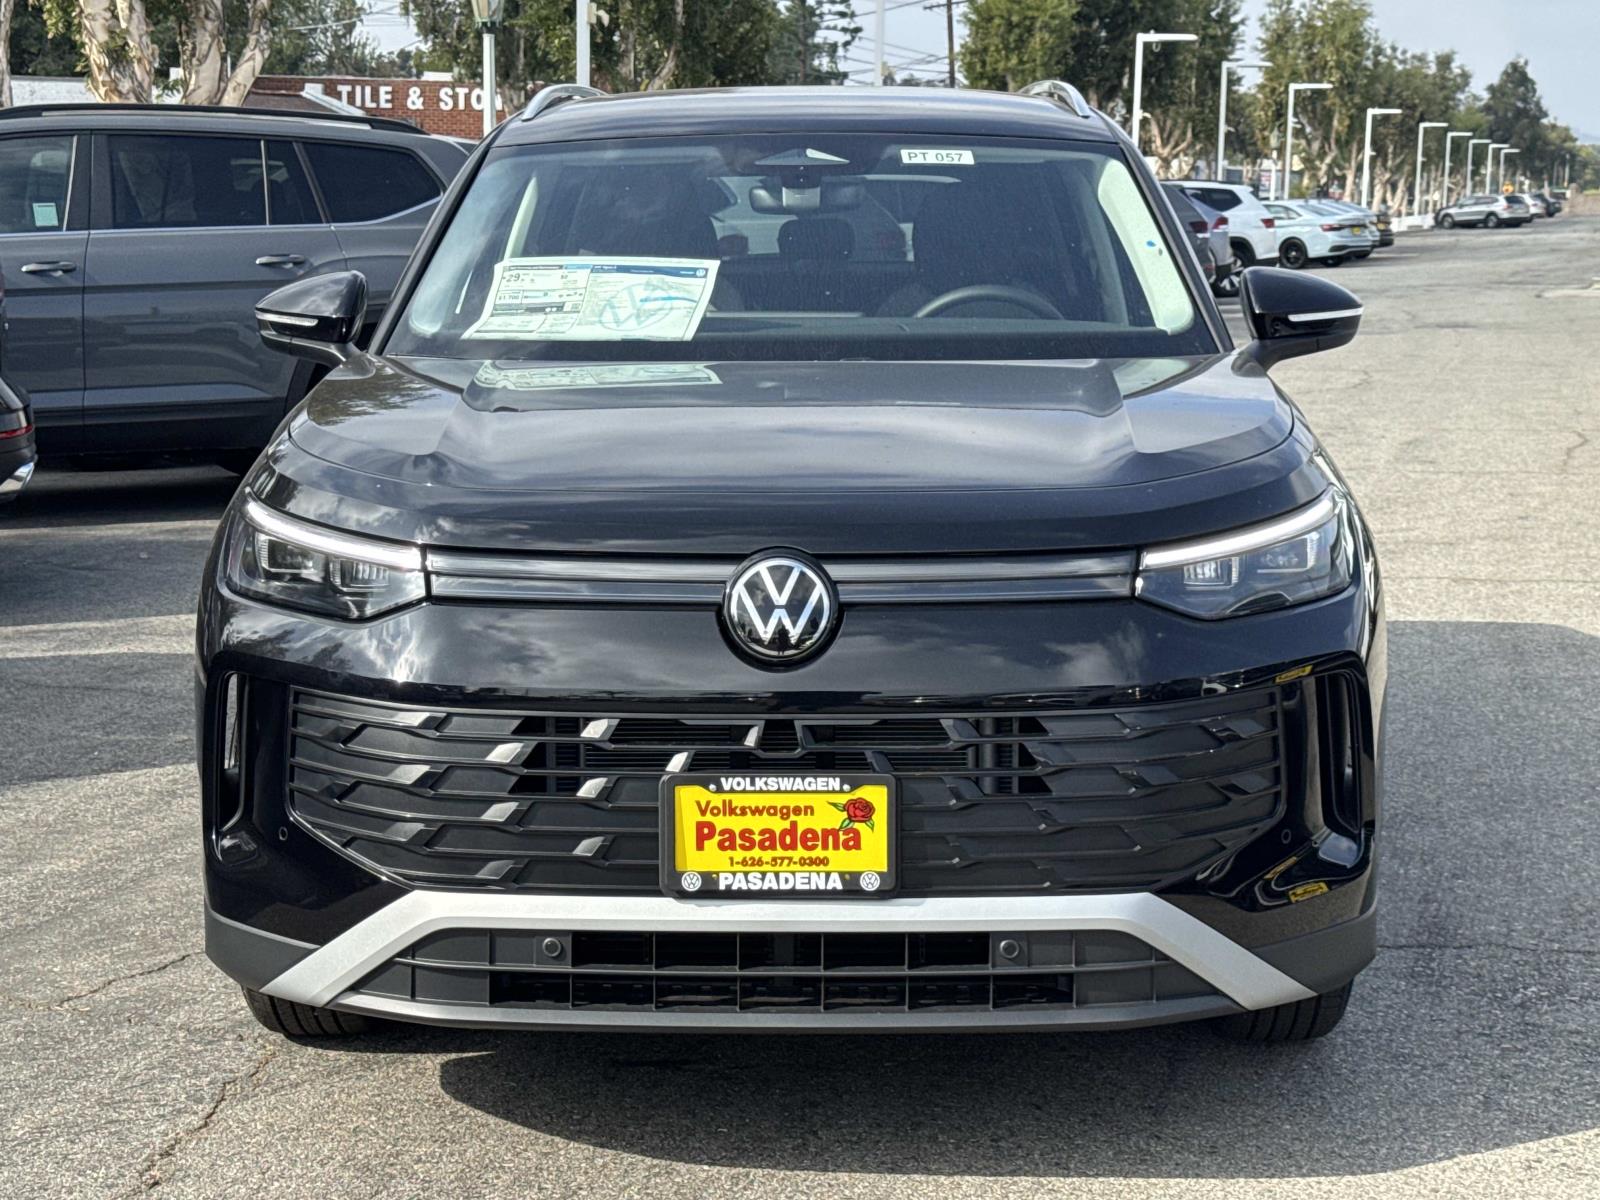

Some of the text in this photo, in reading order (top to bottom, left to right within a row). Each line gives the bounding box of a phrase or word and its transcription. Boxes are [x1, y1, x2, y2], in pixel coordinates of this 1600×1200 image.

[337, 85, 393, 108] TILE
[406, 86, 424, 110] &
[907, 152, 963, 163] PT 057
[720, 777, 840, 791] VOLKSWAGEN
[695, 799, 814, 817] Volkswagen
[695, 820, 862, 851] Pasadena
[728, 856, 830, 867] 1-626-577-0300
[718, 873, 843, 890] PASADENA
